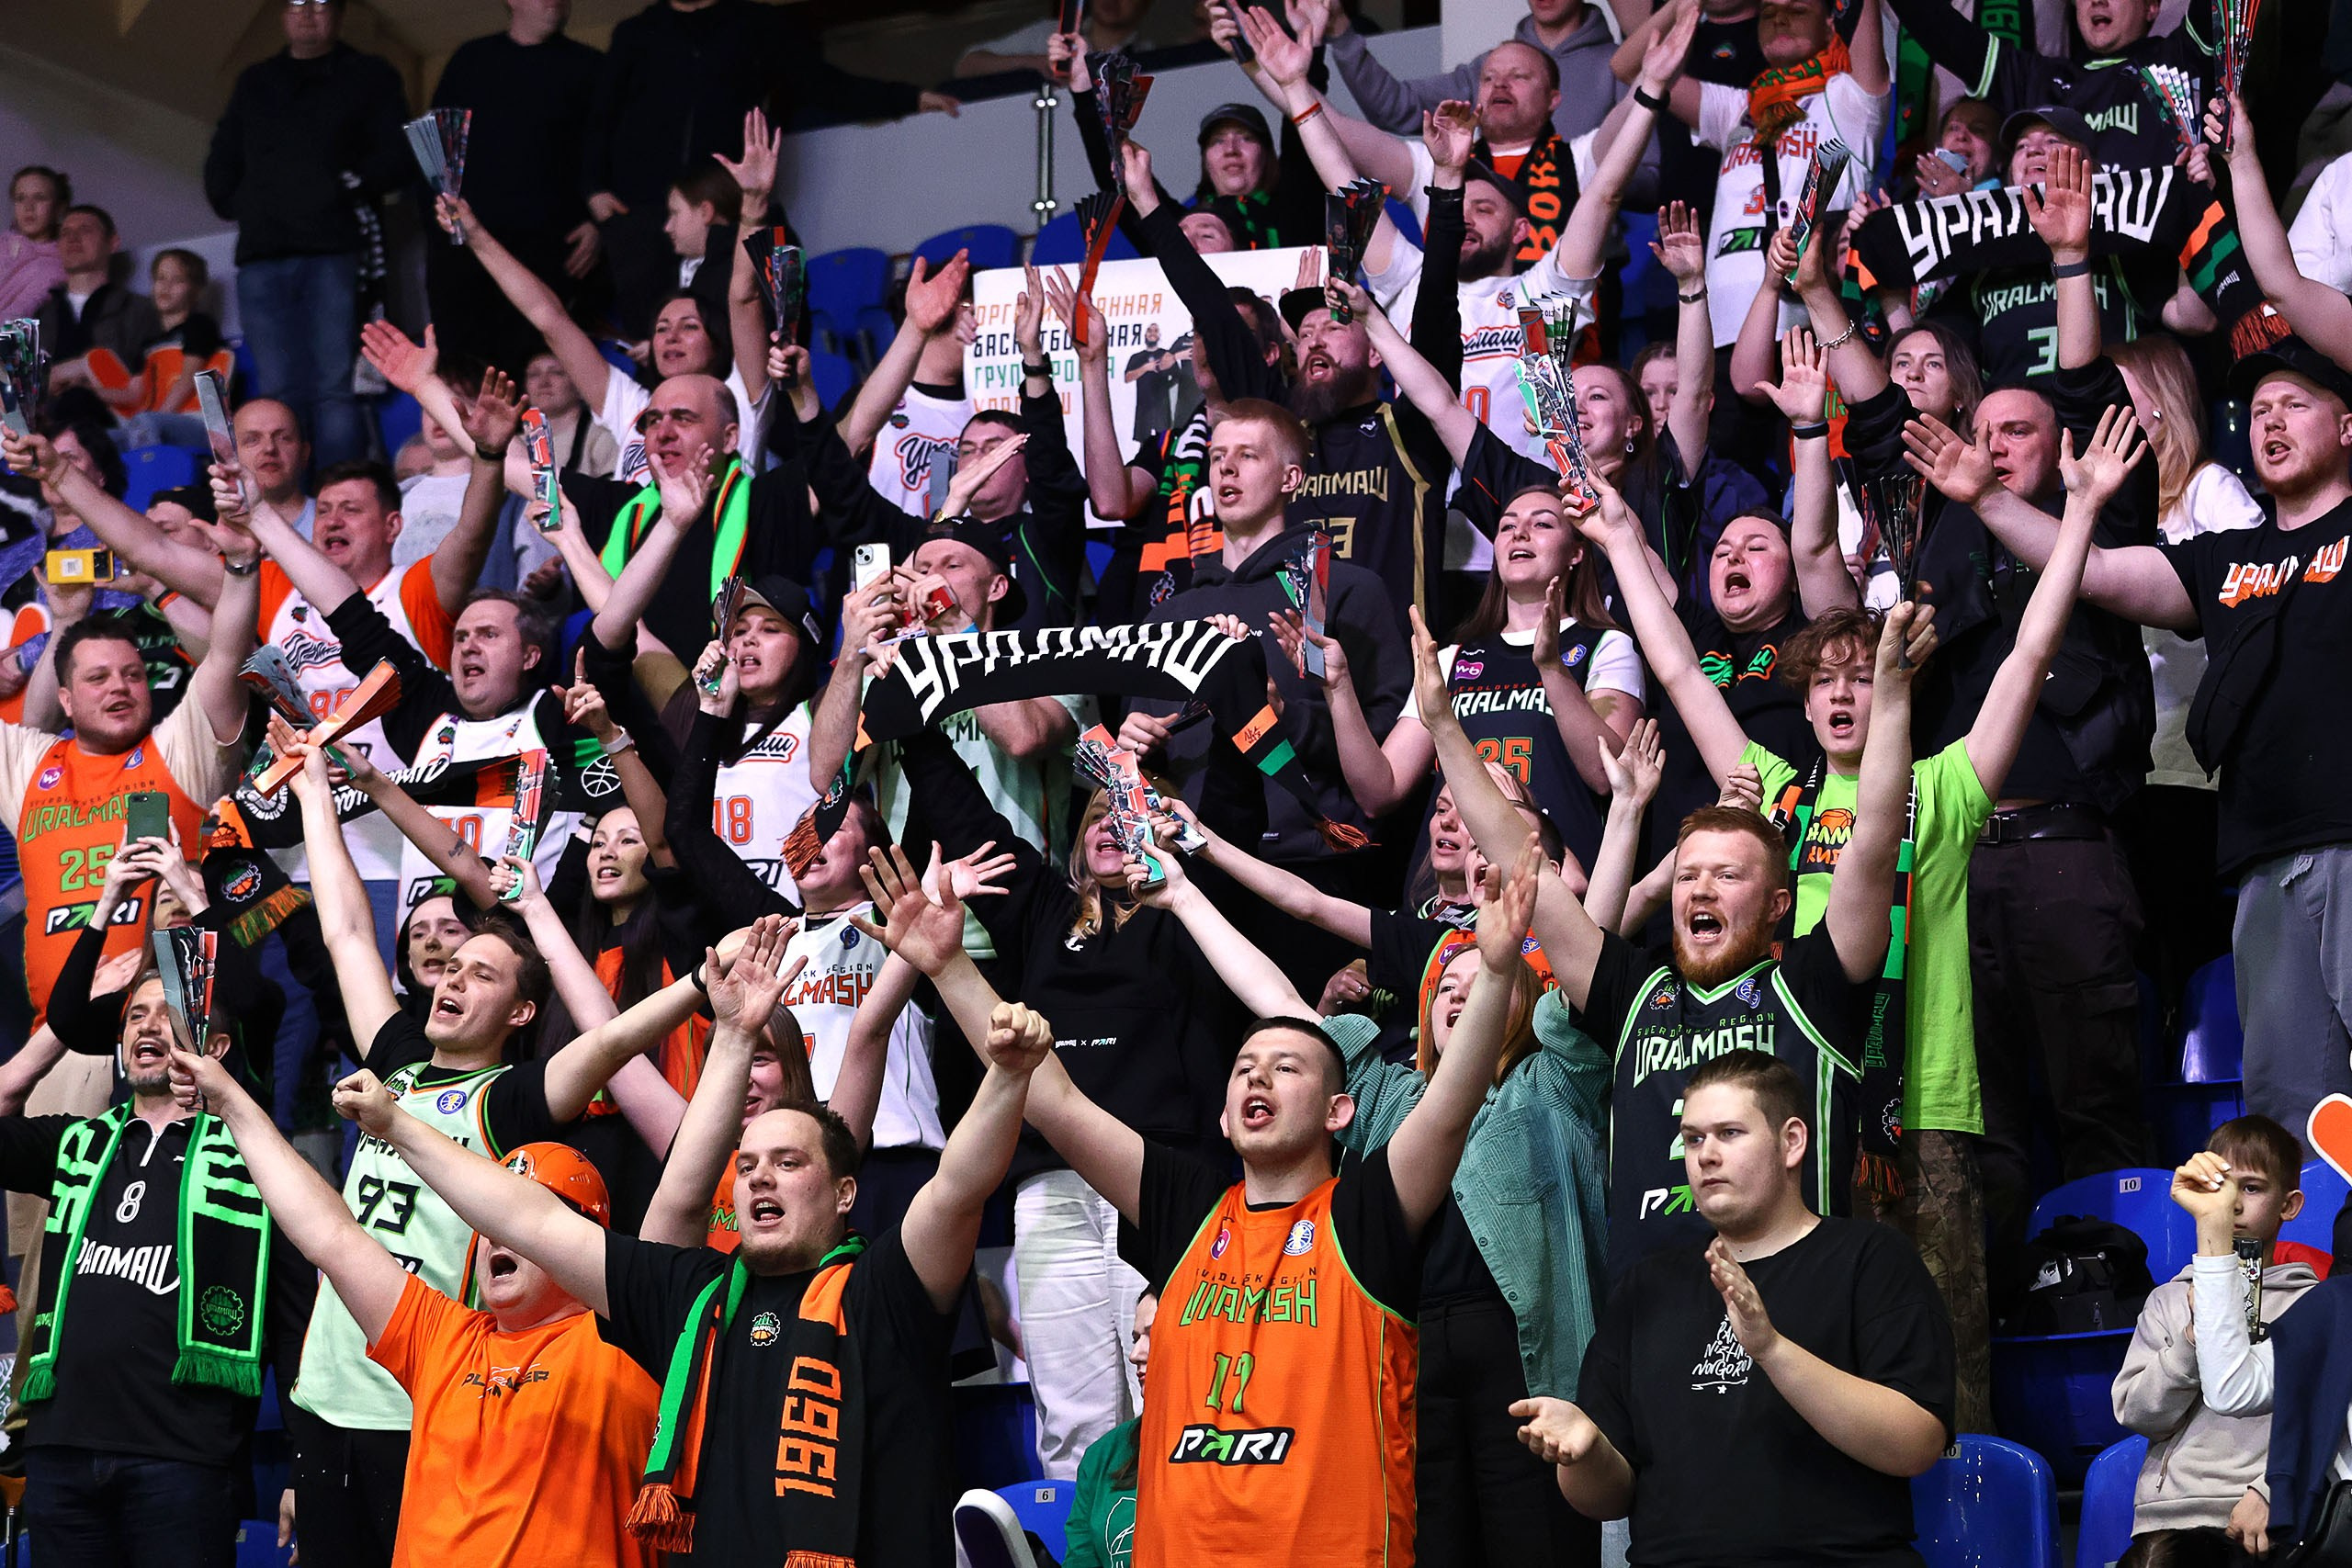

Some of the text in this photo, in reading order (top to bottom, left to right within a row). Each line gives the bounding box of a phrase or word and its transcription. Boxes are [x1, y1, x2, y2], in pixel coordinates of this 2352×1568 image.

[1893, 164, 2174, 282] УРАЛАШ
[1981, 273, 2110, 326] URALMH
[893, 619, 1249, 726] УРАЛМАШ
[24, 789, 157, 844] URALMA
[60, 843, 115, 894] 25
[116, 1180, 146, 1224] 8
[357, 1173, 421, 1236] 93
[2123, 1179, 2138, 1191] 10
[1173, 1428, 1289, 1462] PARI
[1041, 1488, 1050, 1502] 6
